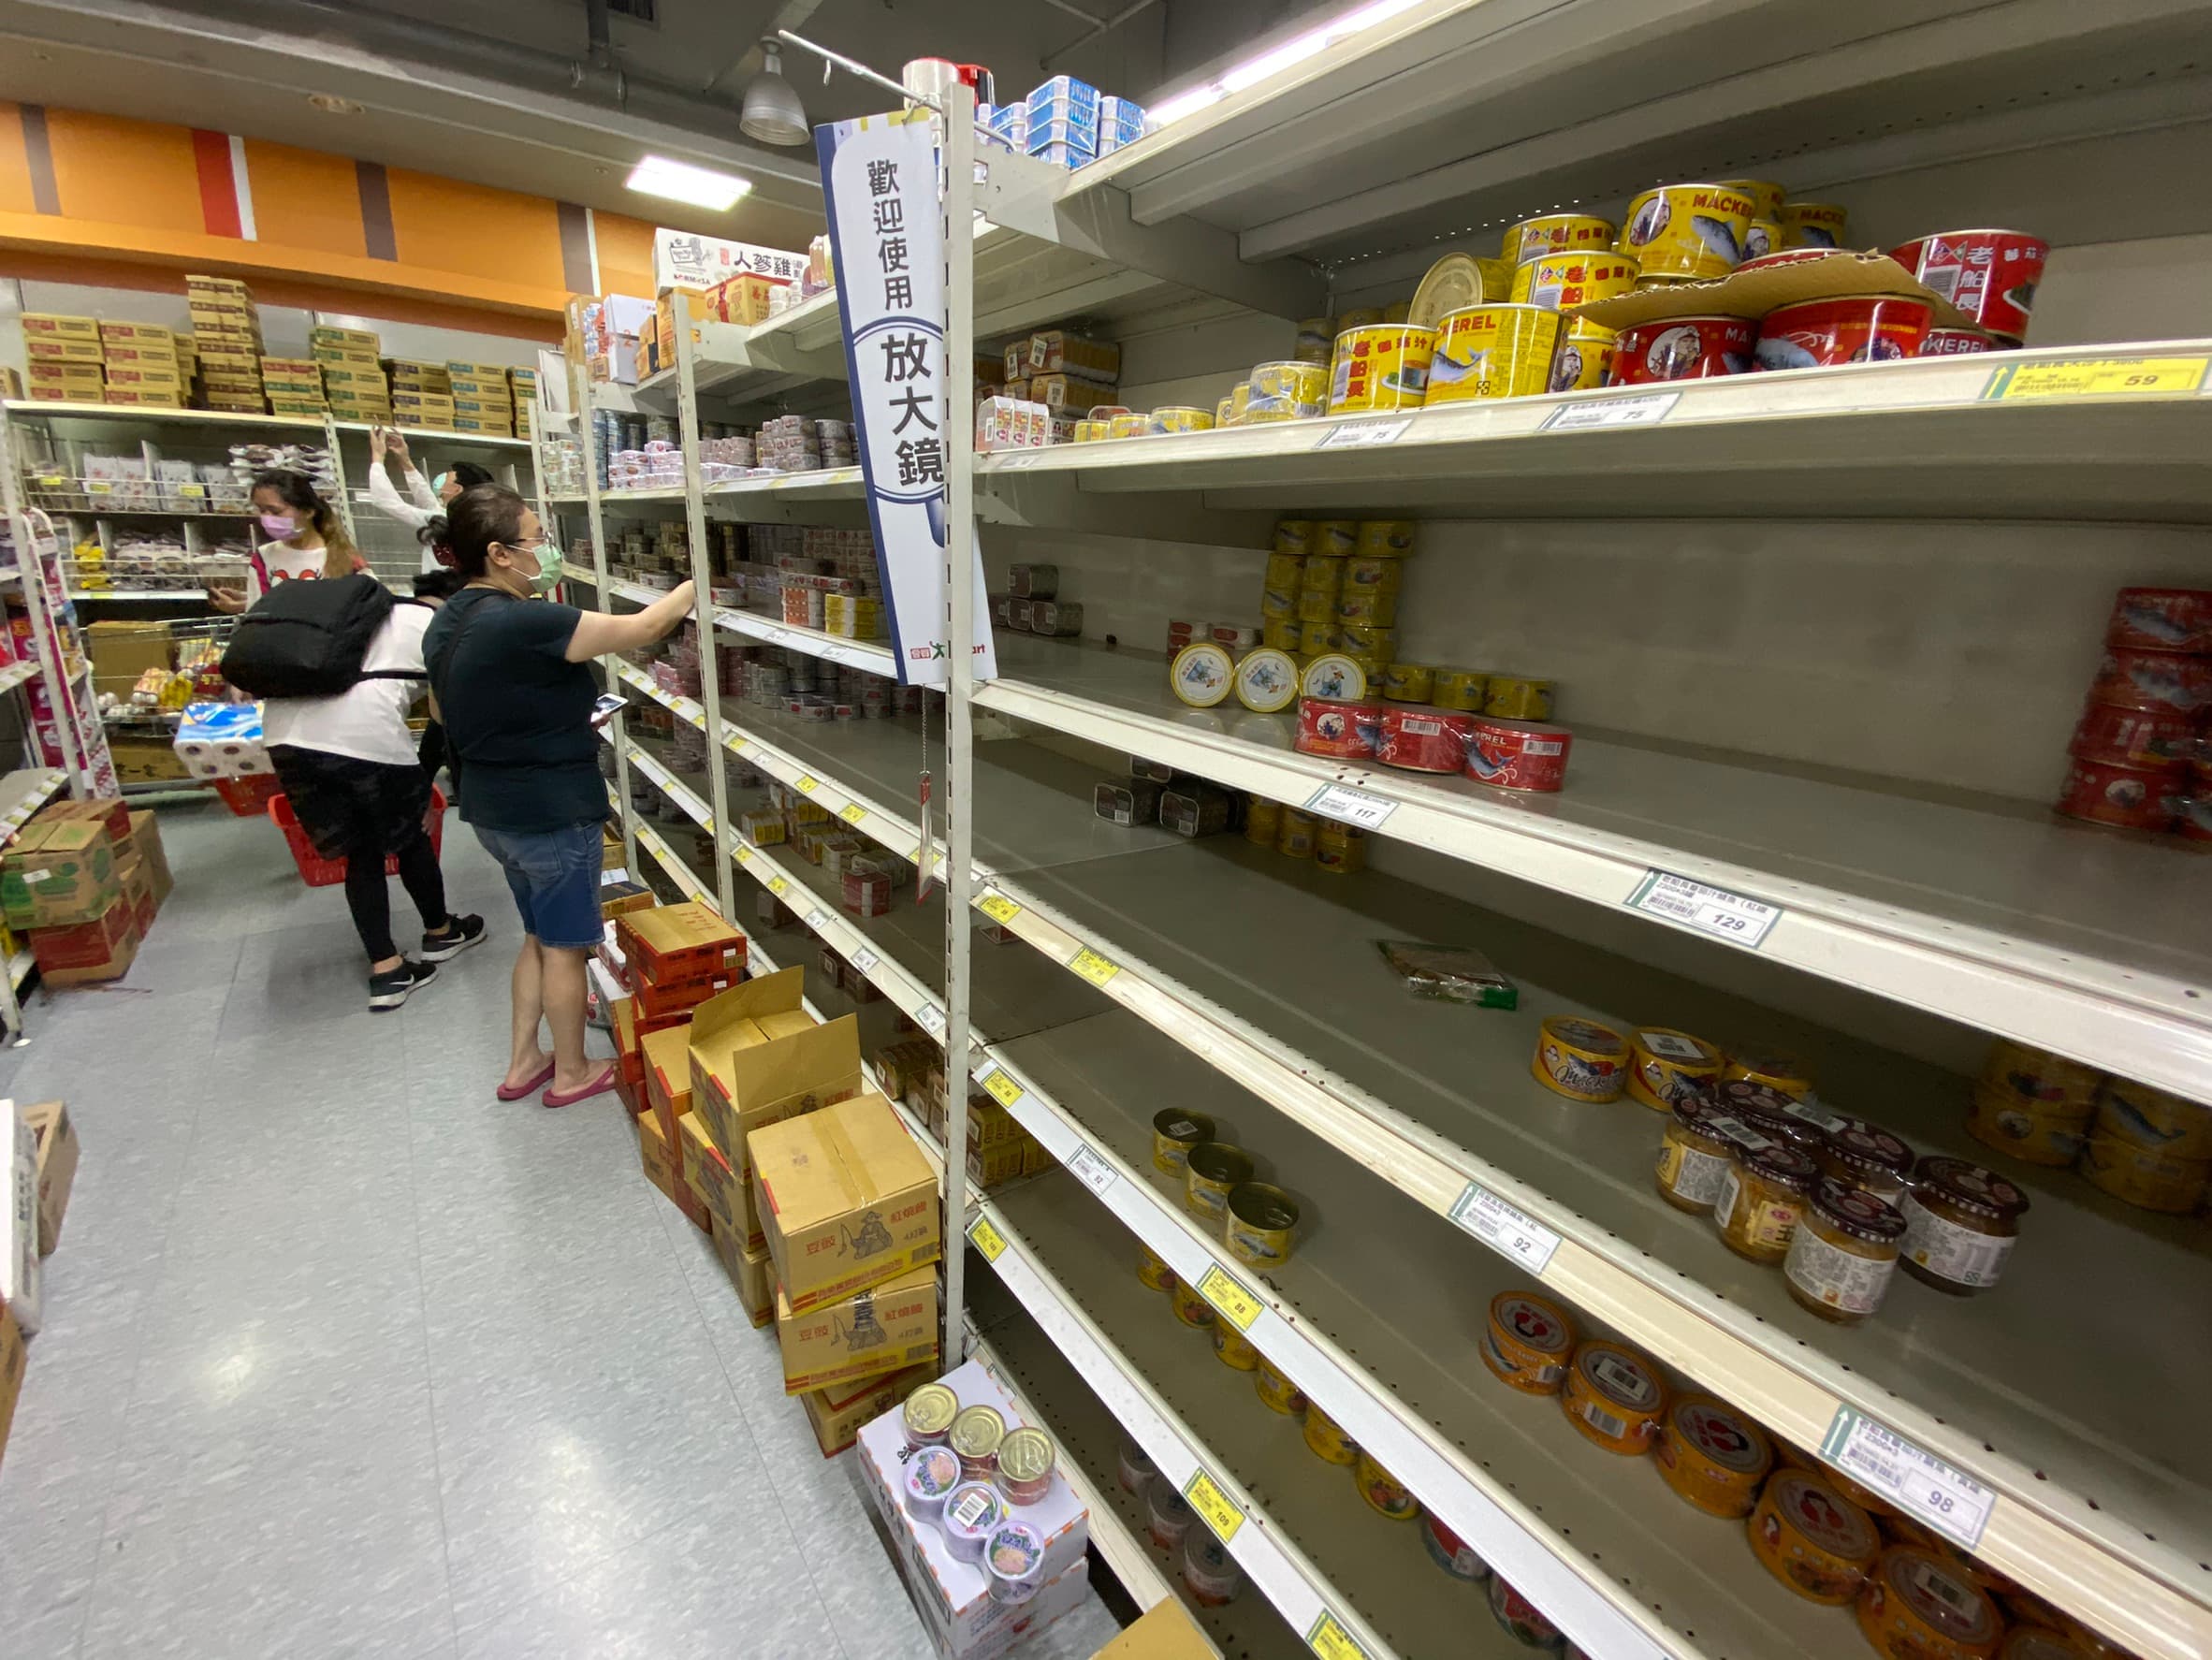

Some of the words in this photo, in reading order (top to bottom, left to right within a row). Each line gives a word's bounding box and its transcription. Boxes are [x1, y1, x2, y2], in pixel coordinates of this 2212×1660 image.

[866, 158, 913, 311] 歡迎使用
[2124, 374, 2159, 386] 59
[880, 332, 944, 487] 放大鏡
[1713, 913, 1746, 931] 129
[1513, 1236, 1532, 1254] 92
[1928, 1490, 1955, 1513] 98
[1215, 1510, 1230, 1527] 109
